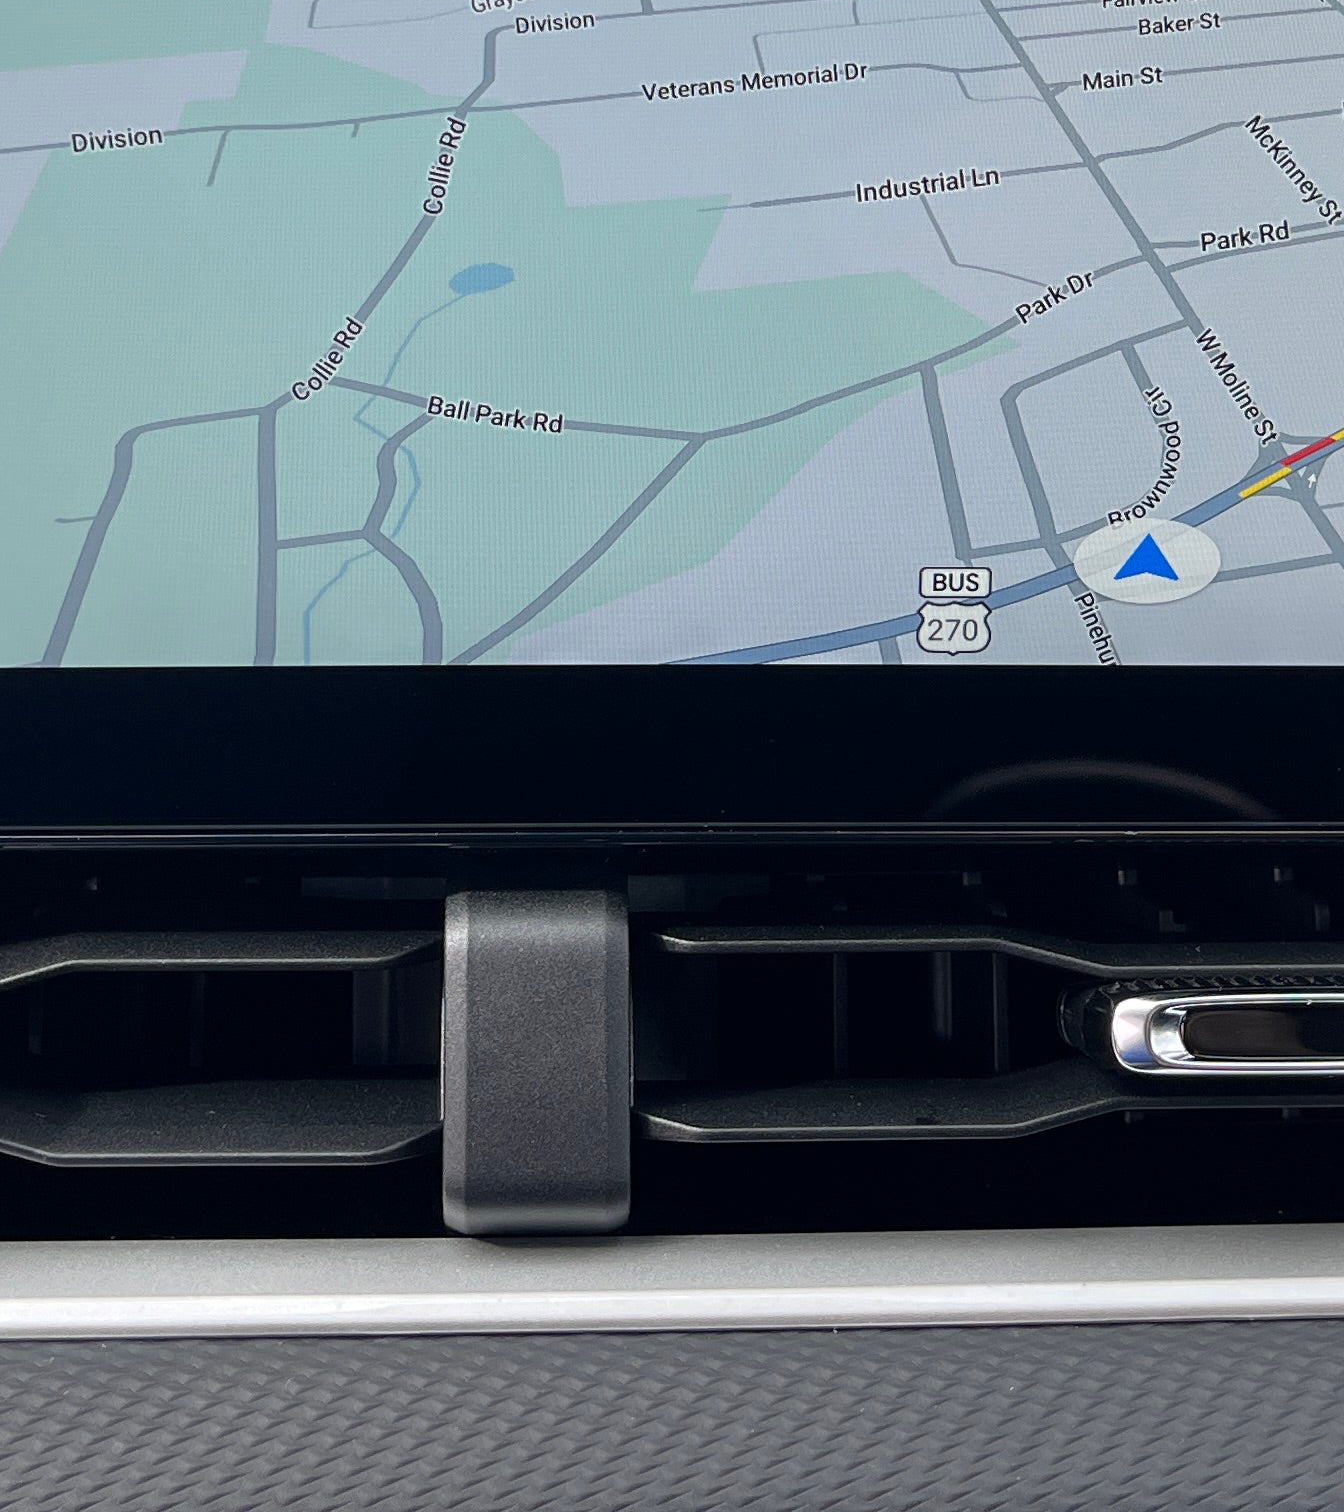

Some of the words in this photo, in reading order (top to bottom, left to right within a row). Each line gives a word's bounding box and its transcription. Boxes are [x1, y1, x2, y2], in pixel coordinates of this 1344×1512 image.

[515, 12, 595, 34] Division
[1138, 16, 1193, 36] Baker
[1200, 13, 1221, 30] St
[642, 78, 735, 102] Veterans
[742, 65, 838, 92] Memorial
[844, 63, 868, 81] Dr
[1083, 70, 1134, 91] Main
[1139, 66, 1164, 84] St
[71, 128, 164, 153] Division
[423, 150, 454, 216] Collie
[439, 117, 466, 150] Rd
[1245, 115, 1324, 204] McKinney
[856, 170, 966, 203] Industrial
[972, 169, 1000, 189] Ln
[1200, 226, 1253, 252] Park
[1259, 220, 1290, 243] Rd
[1016, 286, 1067, 324] Park
[1067, 271, 1095, 297] Dr
[291, 349, 343, 401] Collie
[334, 317, 363, 349] Rd
[1197, 329, 1219, 353] W
[1211, 352, 1258, 419] Moline
[1255, 417, 1277, 446] St
[428, 396, 470, 421] Ball
[475, 404, 526, 428] Park
[533, 412, 564, 434] Rd
[1108, 420, 1181, 527] Brownwood
[1145, 387, 1172, 417] Cir
[932, 573, 980, 592] BUS
[927, 619, 978, 641] 270
